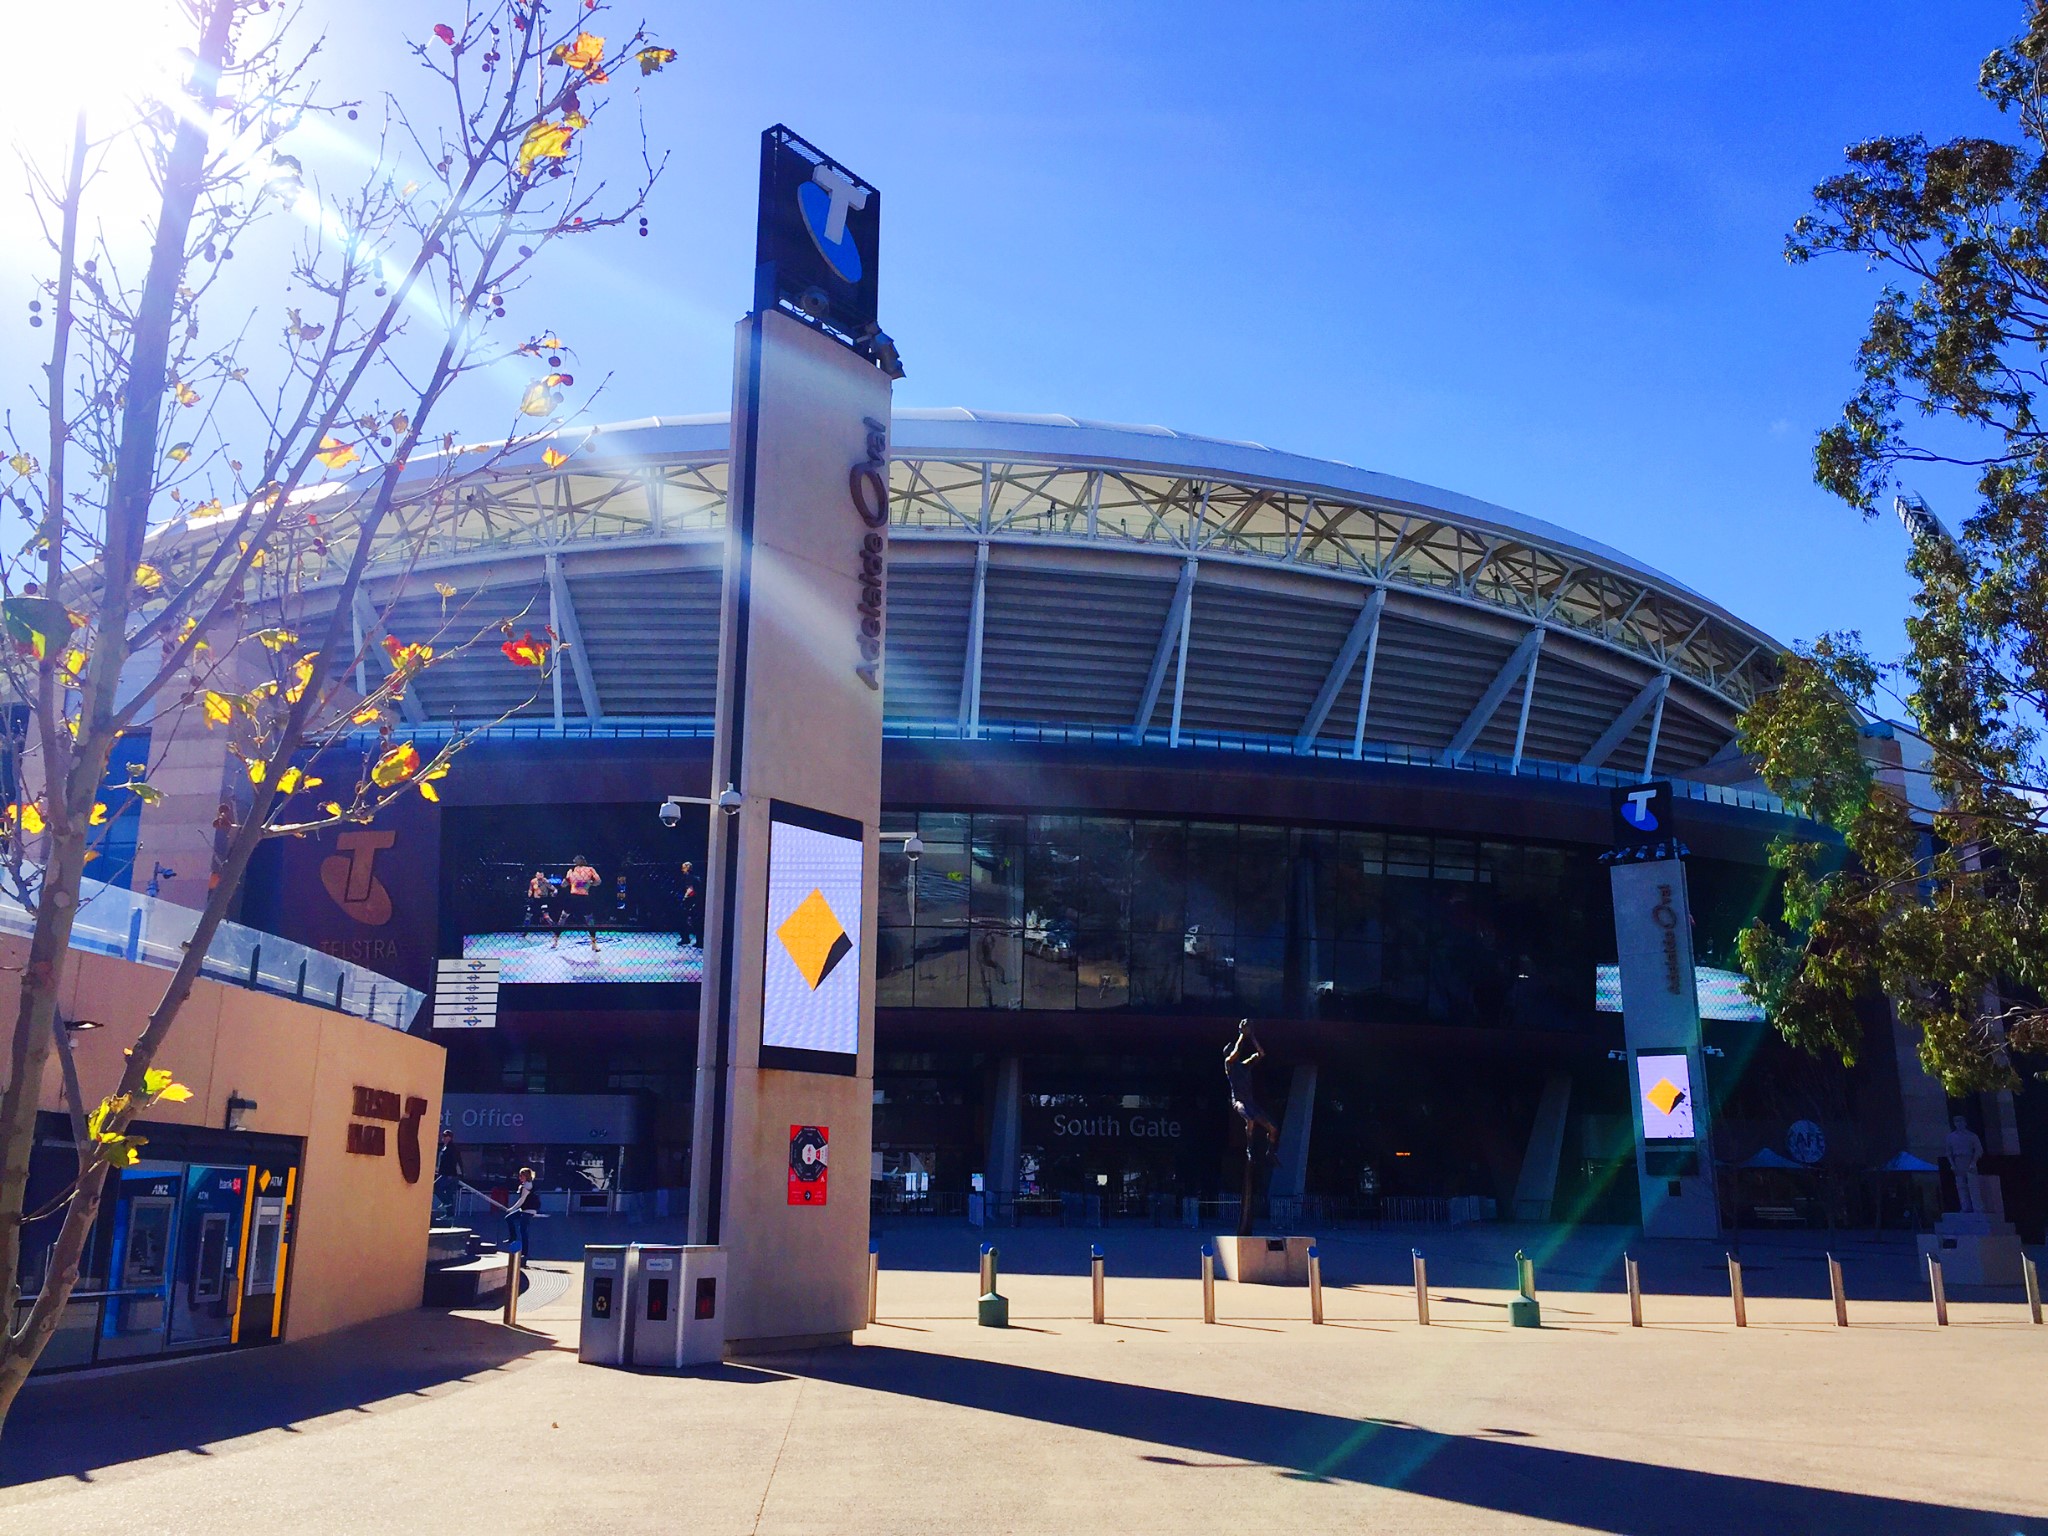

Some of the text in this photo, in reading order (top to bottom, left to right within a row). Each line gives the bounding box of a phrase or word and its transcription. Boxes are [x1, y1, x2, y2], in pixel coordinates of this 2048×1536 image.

[812, 164, 867, 245] T
[849, 417, 889, 690] Adelaide Oval
[1627, 790, 1657, 822] T
[336, 831, 396, 901] T
[1652, 884, 1678, 928] Oval
[320, 939, 398, 959] TELSTRA
[462, 1108, 524, 1127] Office
[1053, 1113, 1182, 1138] South Gate
[152, 1184, 168, 1195] ANZ
[270, 1176, 283, 1187] ATM
[198, 1191, 209, 1200] ATM
